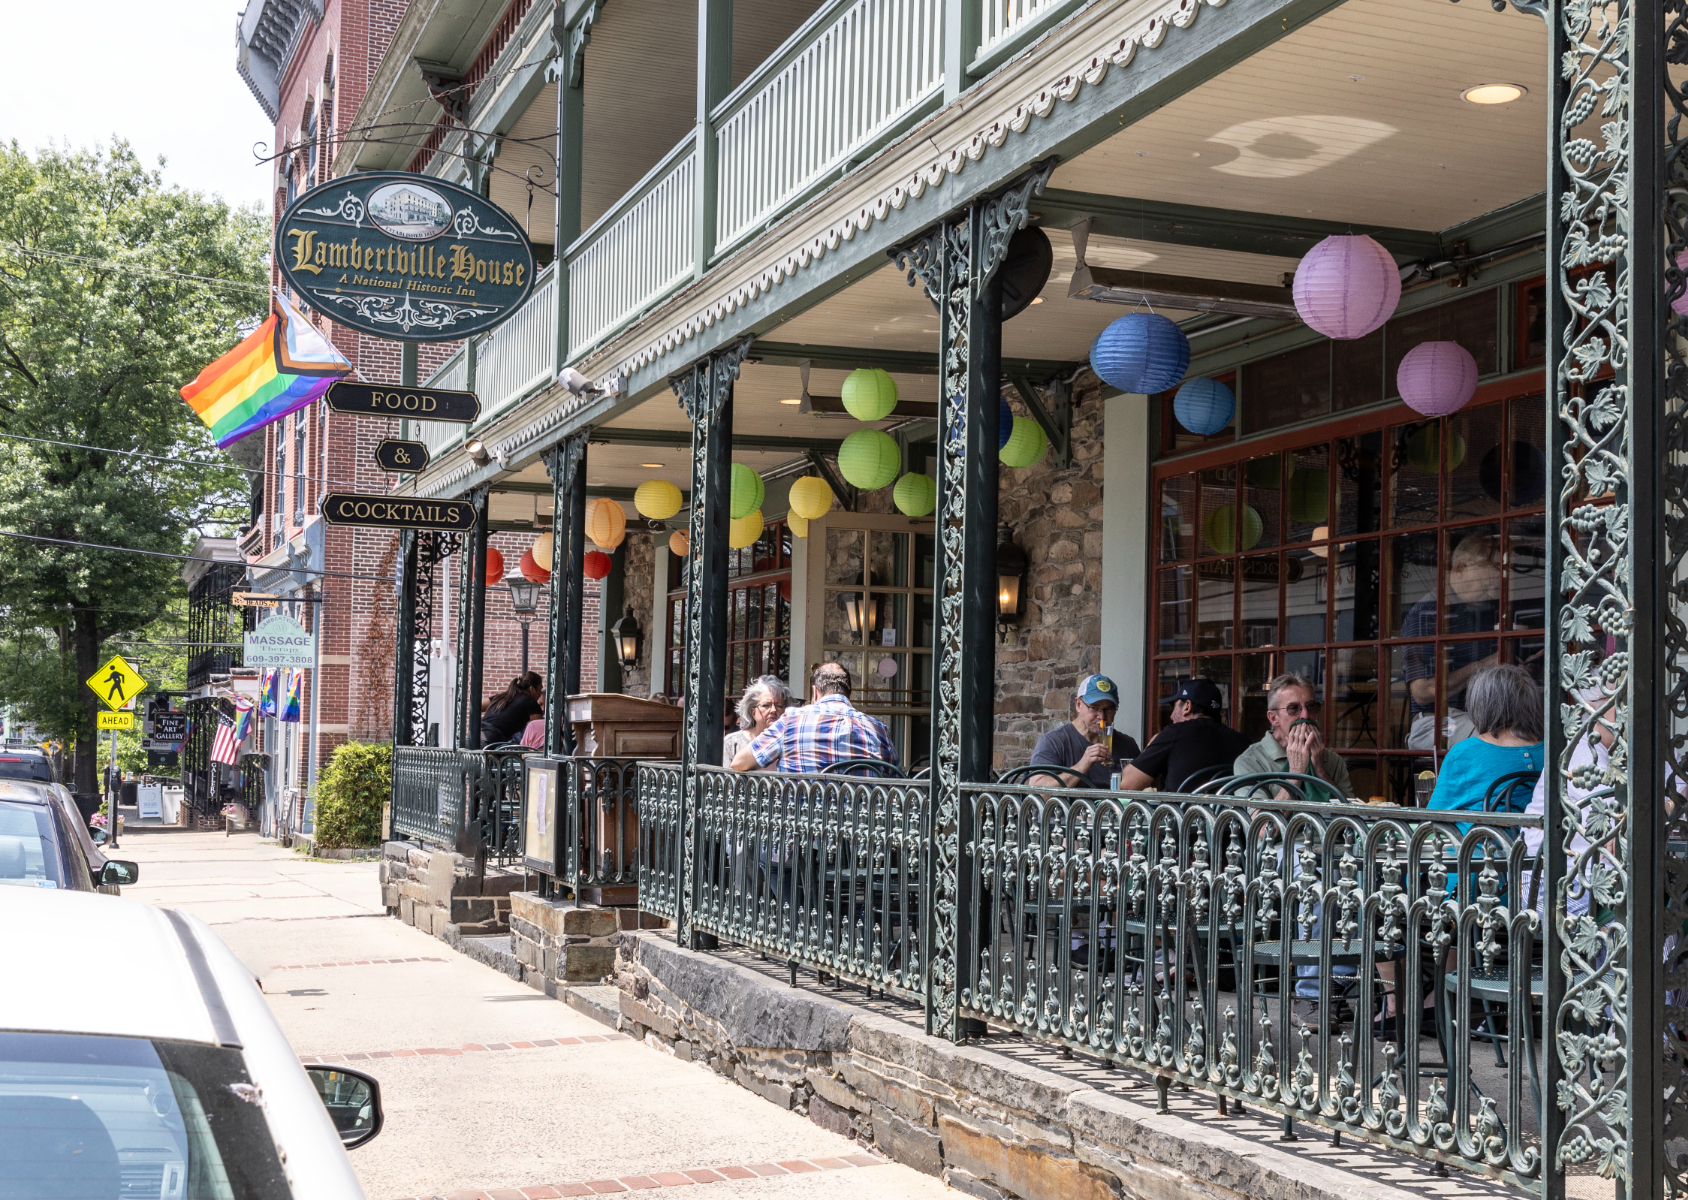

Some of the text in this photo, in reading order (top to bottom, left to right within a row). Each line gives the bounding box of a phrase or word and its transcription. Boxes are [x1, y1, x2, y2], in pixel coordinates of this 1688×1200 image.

[287, 228, 525, 287] Lambertville House
[339, 274, 476, 297] A National Historic Inn
[371, 392, 437, 412] FOOD
[394, 447, 411, 464] &
[339, 501, 459, 523] COCKTAILS
[260, 616, 301, 630] LAMBERTVILLE
[249, 636, 311, 646] MASSAGE
[260, 645, 299, 654] Therapy
[246, 655, 313, 664] 609-397-3808
[102, 716, 129, 725] AHEAD
